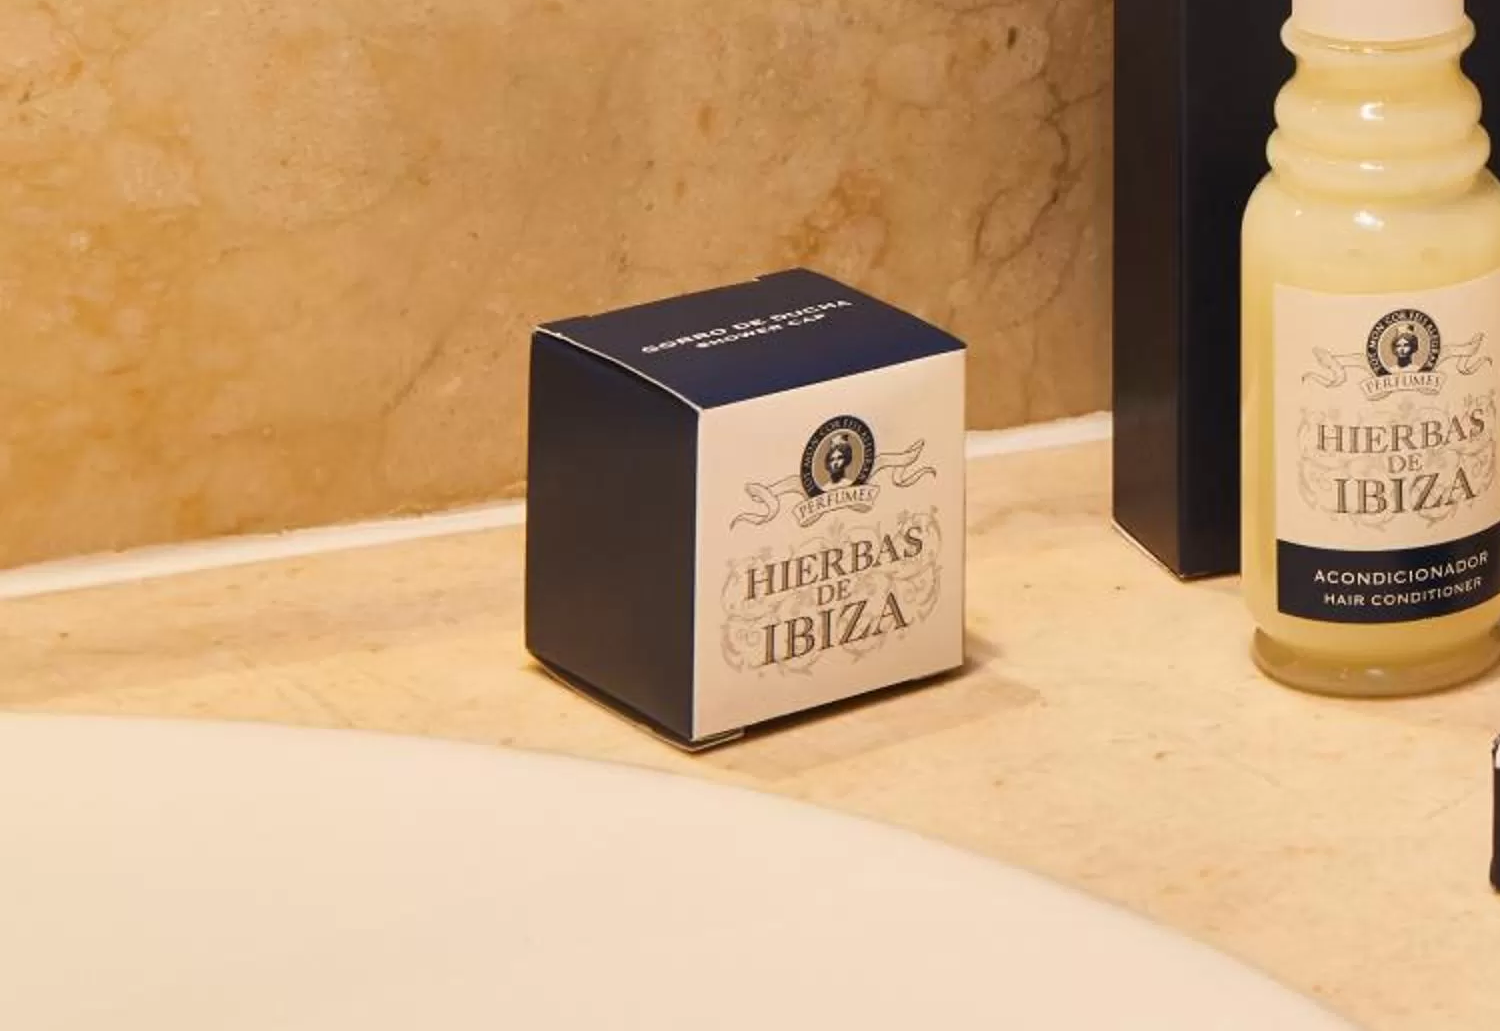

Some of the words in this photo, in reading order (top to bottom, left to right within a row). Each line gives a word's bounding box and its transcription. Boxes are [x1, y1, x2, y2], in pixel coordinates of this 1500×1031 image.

[641, 328, 727, 353] GORRO
[732, 319, 767, 330] DE
[770, 300, 853, 321] DUCHA
[1366, 374, 1440, 393] PERFUMES
[1316, 408, 1486, 454] HIERBAS
[1387, 452, 1424, 474] DE
[799, 488, 874, 518] PERFUMES
[1334, 467, 1477, 515] IBIZA
[744, 525, 924, 601] HIERBAS
[1314, 550, 1489, 585] ACONDICIONADOR
[816, 577, 851, 606] DE
[1323, 592, 1365, 607] HAIR
[1371, 576, 1482, 607] CONDITIONER
[759, 590, 909, 667] IBIZA
